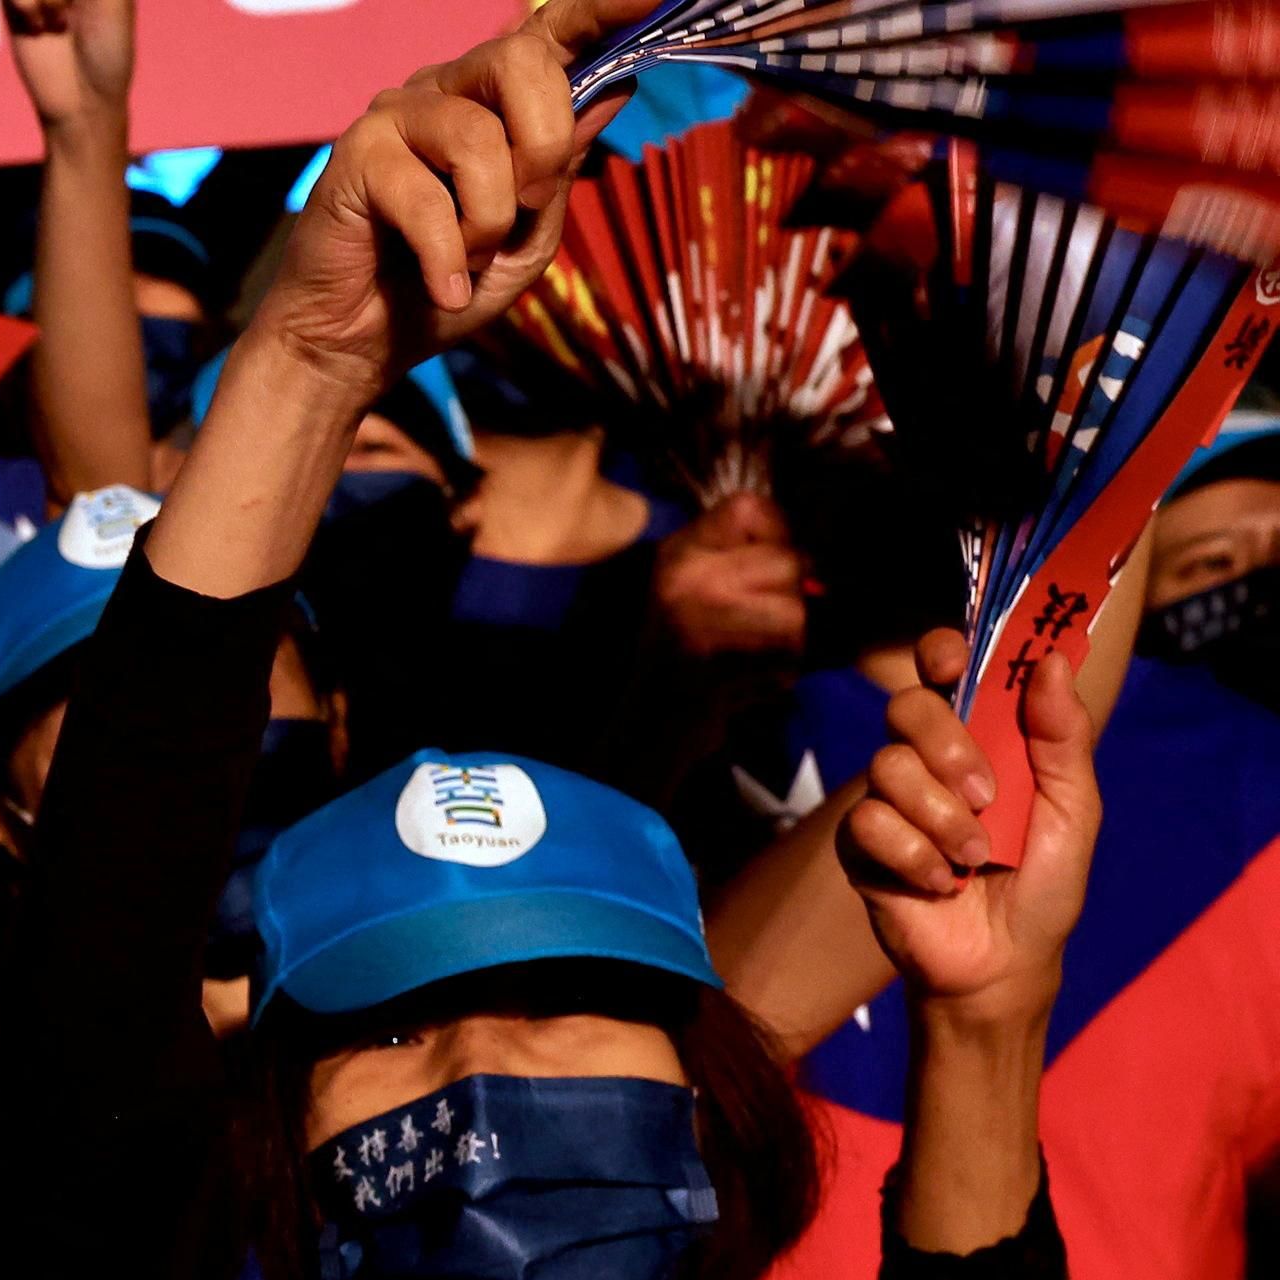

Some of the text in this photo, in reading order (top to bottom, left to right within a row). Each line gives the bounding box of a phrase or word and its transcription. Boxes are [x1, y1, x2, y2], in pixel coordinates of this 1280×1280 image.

[434, 831, 521, 848] Taoyuan
[333, 1098, 455, 1182] 支持善哥
